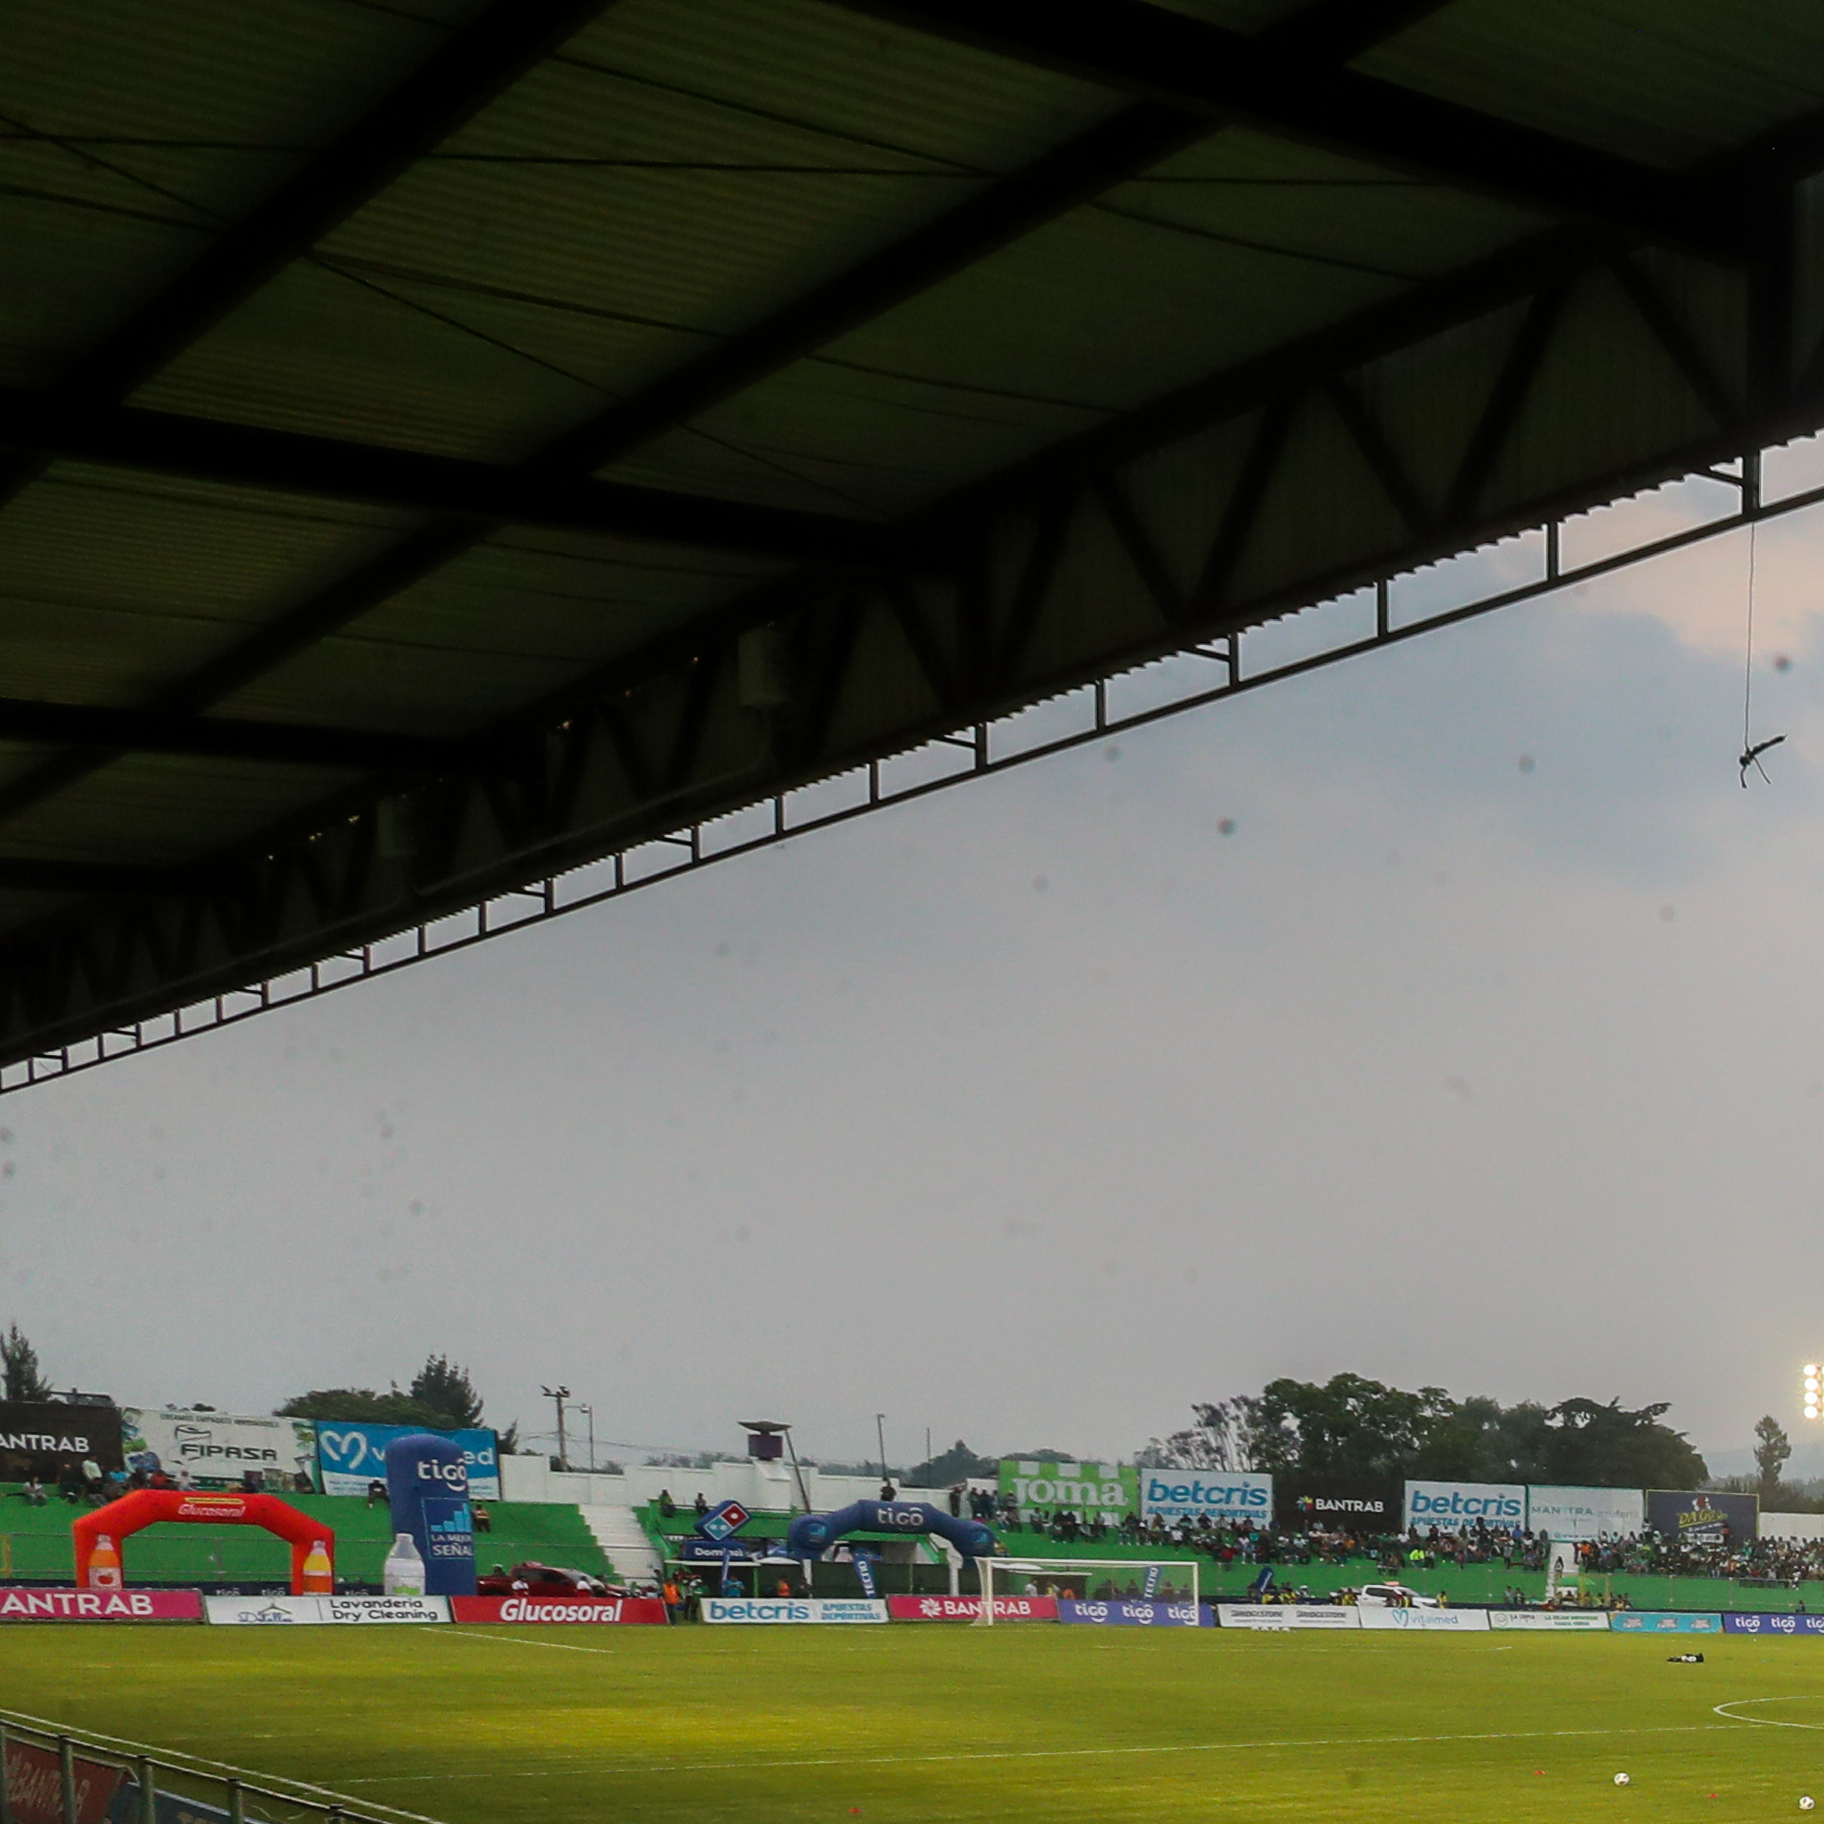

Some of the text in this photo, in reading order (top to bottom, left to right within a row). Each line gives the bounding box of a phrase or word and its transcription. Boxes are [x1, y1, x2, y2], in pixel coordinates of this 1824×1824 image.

[181, 1443, 278, 1462] FIPASA
[1149, 1478, 1268, 1507] betcris
[1315, 1498, 1384, 1513] BANTRAB
[1411, 1490, 1521, 1516] betcris
[433, 1543, 473, 1556] SEÑA
[0, 1593, 154, 1616] ANTRAB
[500, 1599, 623, 1622] Glucosoral
[710, 1601, 809, 1620] betcris
[333, 1608, 438, 1622] Dry Cleaning
